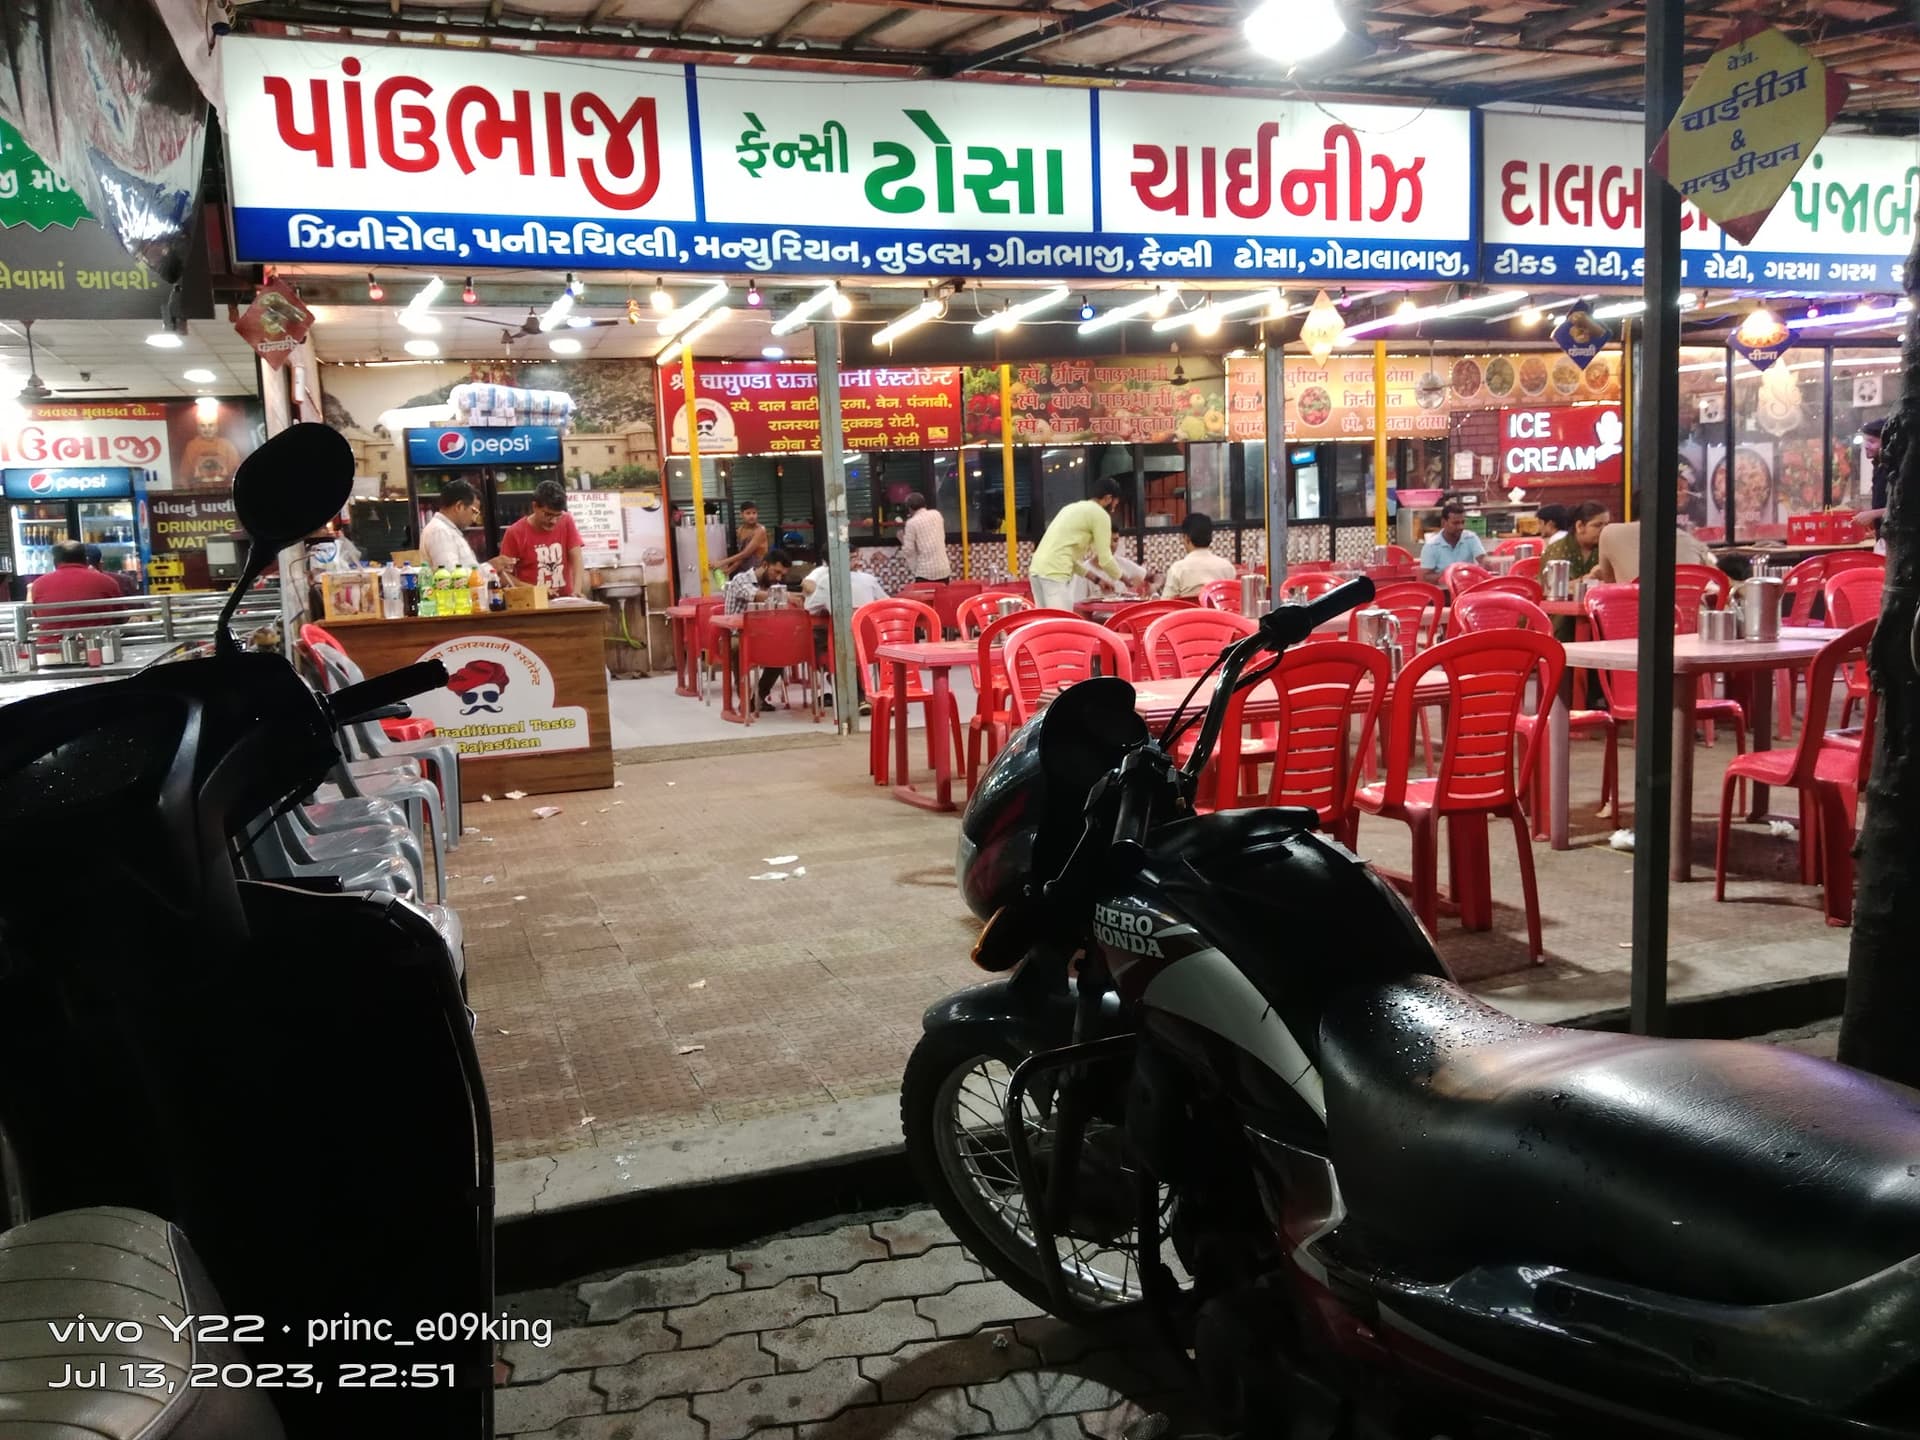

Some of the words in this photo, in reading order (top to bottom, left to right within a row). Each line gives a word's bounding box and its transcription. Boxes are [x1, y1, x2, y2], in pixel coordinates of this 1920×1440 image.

[1681, 66, 1808, 132] चाईनीज
[263, 57, 660, 211] પાંઉભાજી
[1730, 128, 1746, 151] &
[735, 111, 849, 178] ફેન્સી
[864, 109, 1064, 215] ઢોસા
[1130, 121, 1426, 223] ચાઈનીઝ
[1138, 237, 1212, 271] ફેન્સી
[1763, 260, 1820, 281] ગરમા
[1828, 263, 1877, 281] ગરમ
[700, 373, 772, 396] चामुण्डा
[1051, 361, 1090, 387] ग्रीन
[758, 400, 786, 411] दाल
[1510, 412, 1552, 438] ICE
[471, 434, 531, 456] pepsi
[847, 433, 889, 449] चपाती
[892, 432, 920, 447] रोटी
[1506, 446, 1596, 474] CREAM
[55, 474, 108, 492] pepsi
[152, 500, 198, 517] પીવાનું
[582, 493, 609, 501] TABLE
[157, 519, 236, 534] DRINKING
[167, 536, 207, 549] WAT
[435, 721, 525, 739] Traditional
[530, 717, 576, 731] Taste
[457, 737, 542, 754] Rajasthan
[1095, 903, 1153, 936] HERO
[1092, 920, 1165, 959] HONDA
